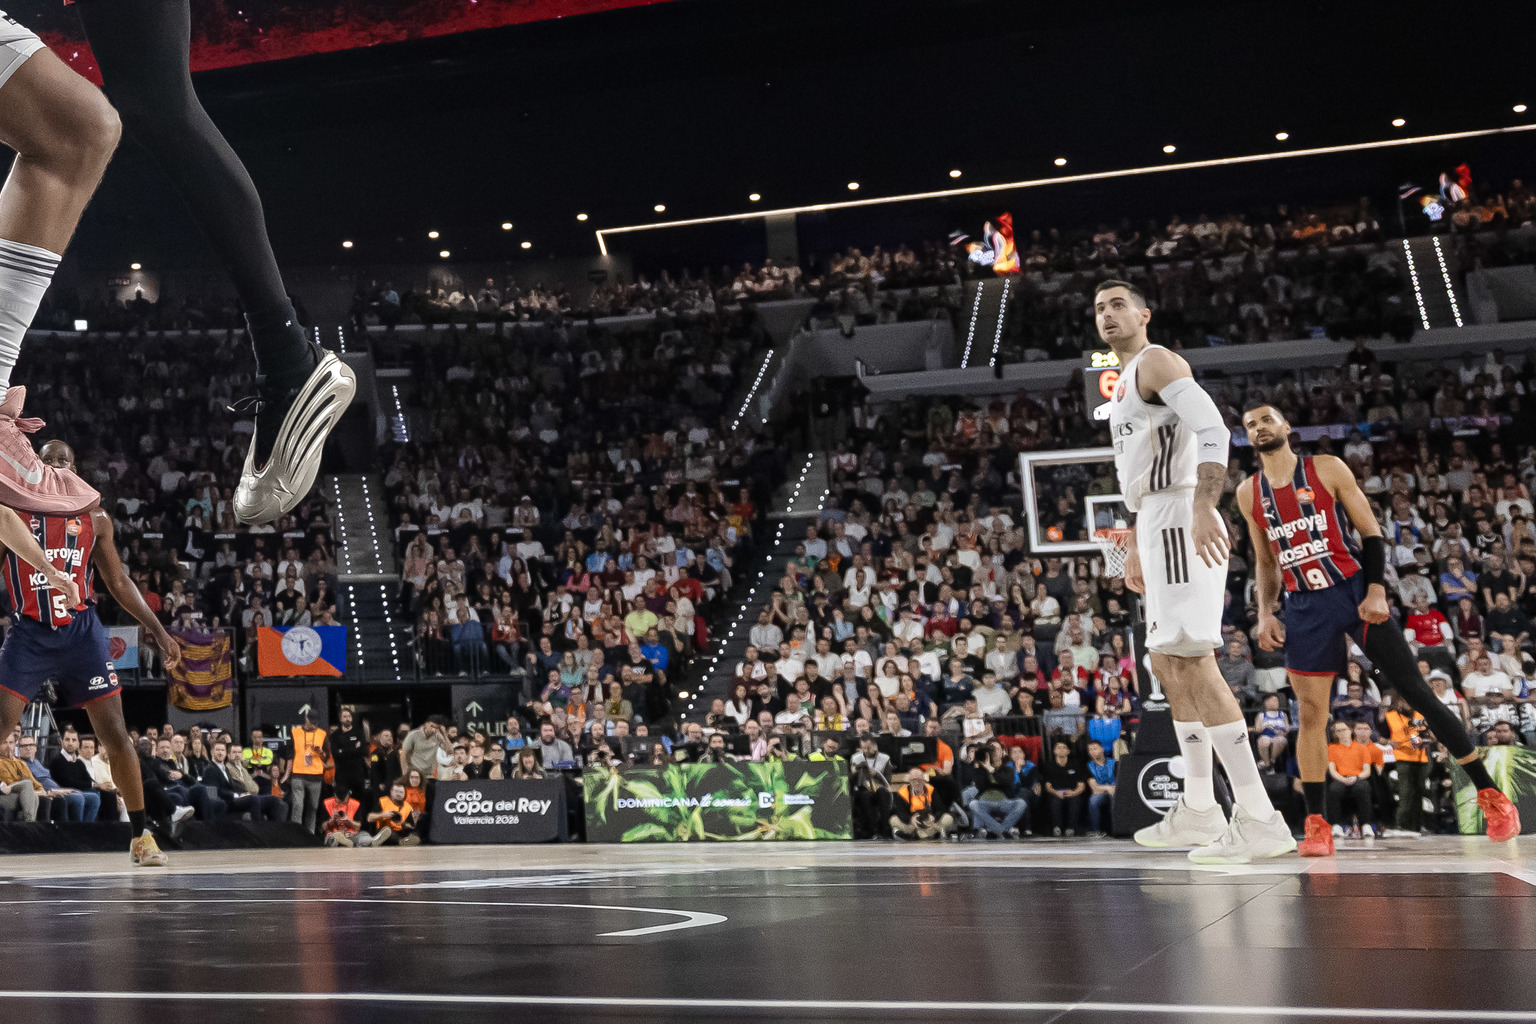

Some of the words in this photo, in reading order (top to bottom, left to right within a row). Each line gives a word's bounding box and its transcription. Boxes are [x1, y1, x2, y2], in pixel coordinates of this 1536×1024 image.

[1091, 352, 1120, 368] 2:0
[1266, 509, 1328, 542] kingroyal
[45, 547, 84, 566] groyal
[1306, 568, 1330, 591] 9
[53, 595, 67, 619] 5
[467, 721, 508, 737] SALID
[1148, 781, 1178, 790] Copa
[456, 789, 482, 801] acb
[618, 796, 699, 809] DOMINICANA
[444, 797, 493, 816] Copa
[495, 800, 516, 811] del
[517, 797, 551, 815] Rey
[453, 816, 494, 825] Valencia
[495, 816, 519, 825] 2026
